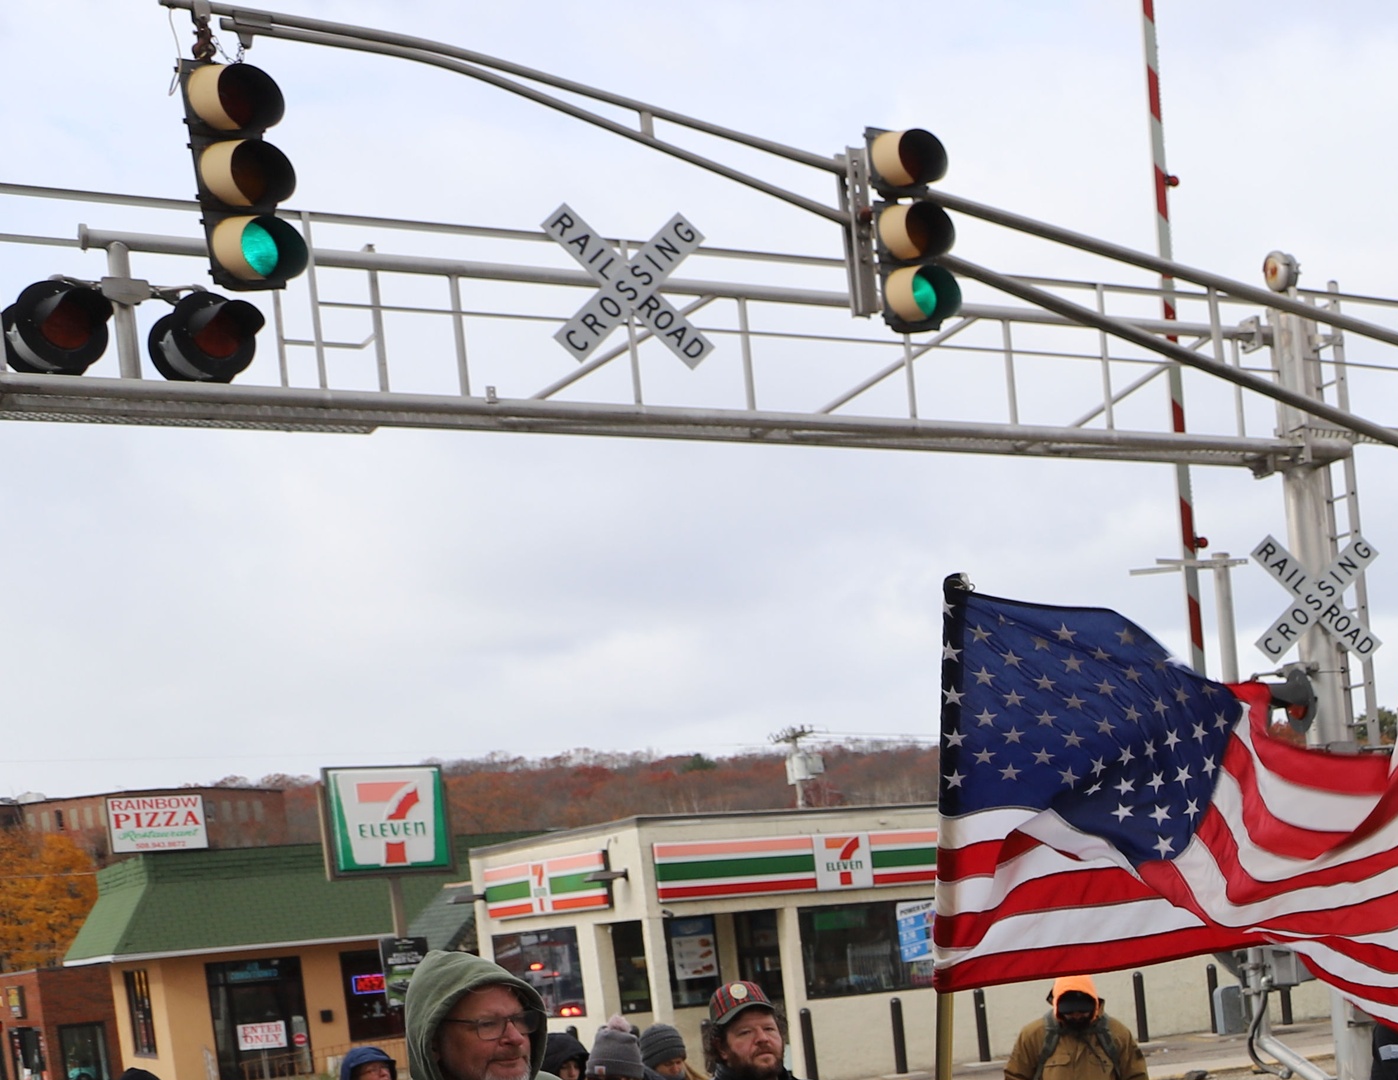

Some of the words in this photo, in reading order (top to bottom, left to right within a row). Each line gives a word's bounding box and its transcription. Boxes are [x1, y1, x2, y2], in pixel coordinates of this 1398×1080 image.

[551, 212, 615, 280] RAIL
[565, 222, 696, 352] CROSSING
[637, 295, 705, 359] ROAD
[1257, 542, 1306, 595] RAIL
[1264, 541, 1371, 655] CROSSING
[1321, 603, 1374, 654] ROAD
[110, 796, 199, 812] RAINBOW
[113, 810, 202, 830] PIZZA
[355, 781, 420, 864] 7
[825, 836, 860, 886] 7
[242, 1023, 283, 1035] ENTER
[244, 1033, 282, 1045] ONLY
